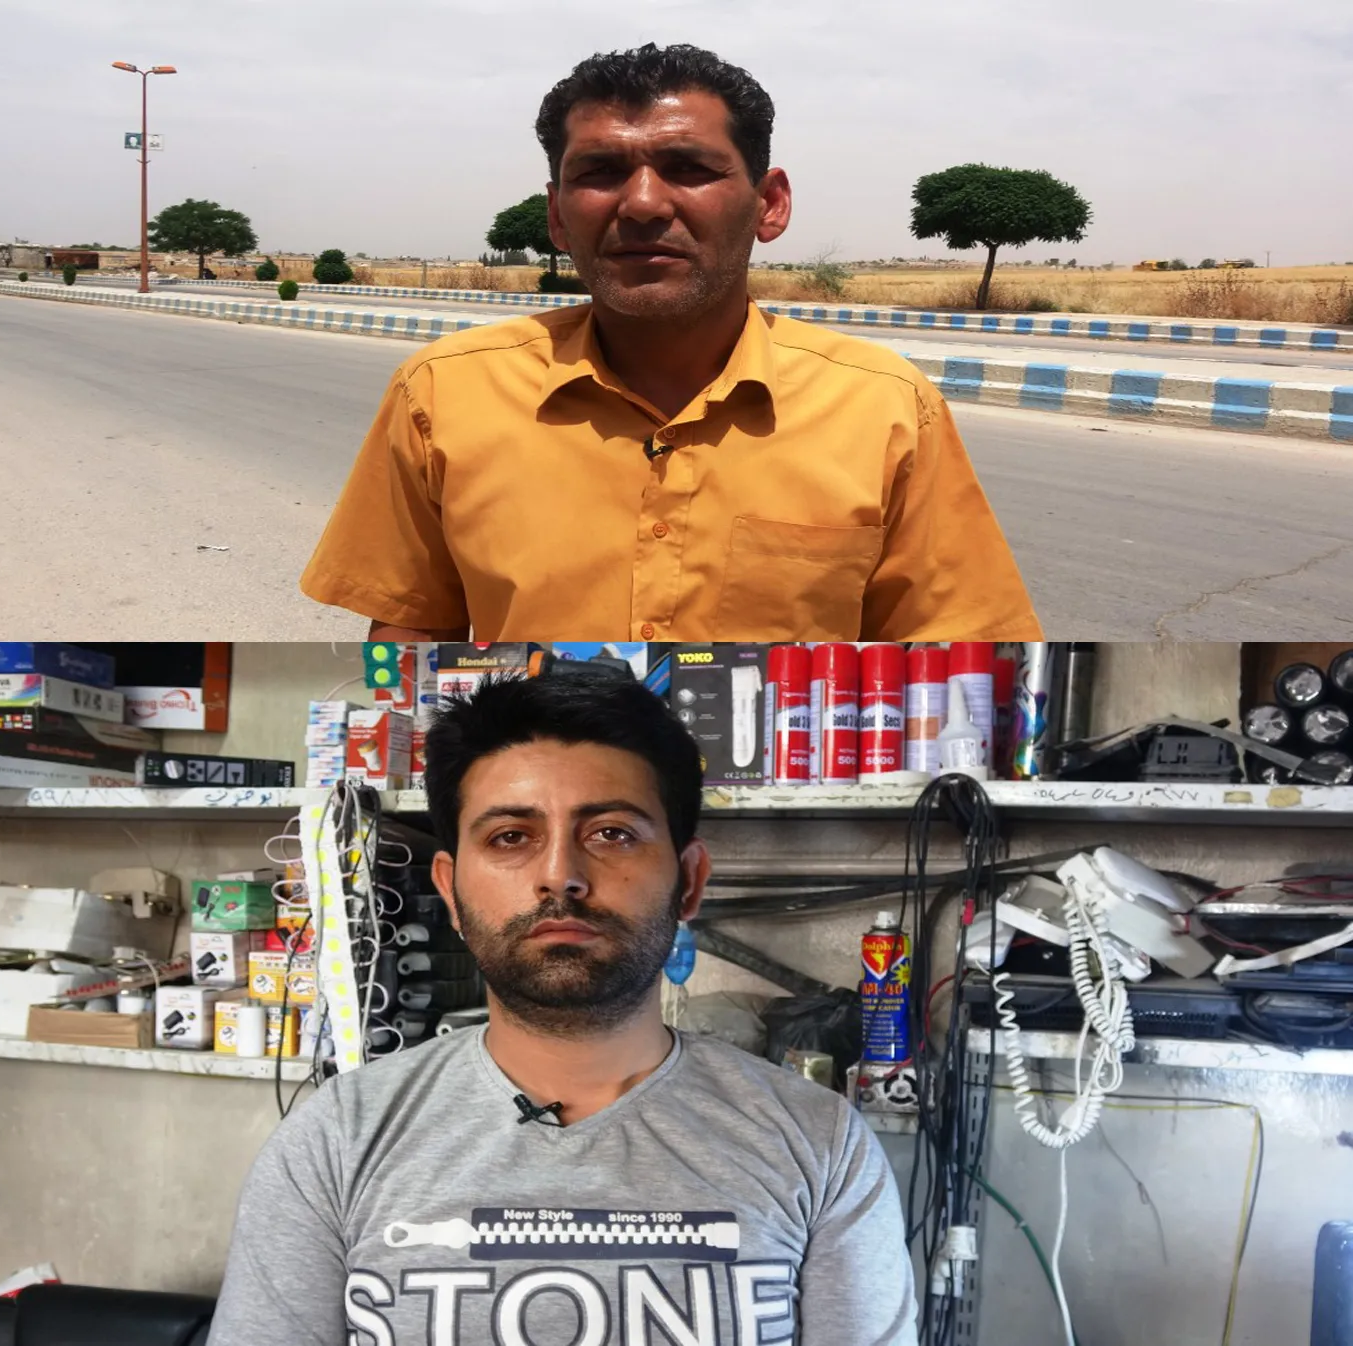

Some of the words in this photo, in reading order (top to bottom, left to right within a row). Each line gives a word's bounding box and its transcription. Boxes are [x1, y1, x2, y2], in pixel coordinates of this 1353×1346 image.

[457, 657, 498, 667] Hondai
[677, 652, 714, 663] YOKO
[504, 1209, 535, 1220] New
[538, 1209, 574, 1222] Style
[608, 1212, 646, 1223] since
[650, 1212, 682, 1223] 1990
[345, 1260, 795, 1346] STONE
